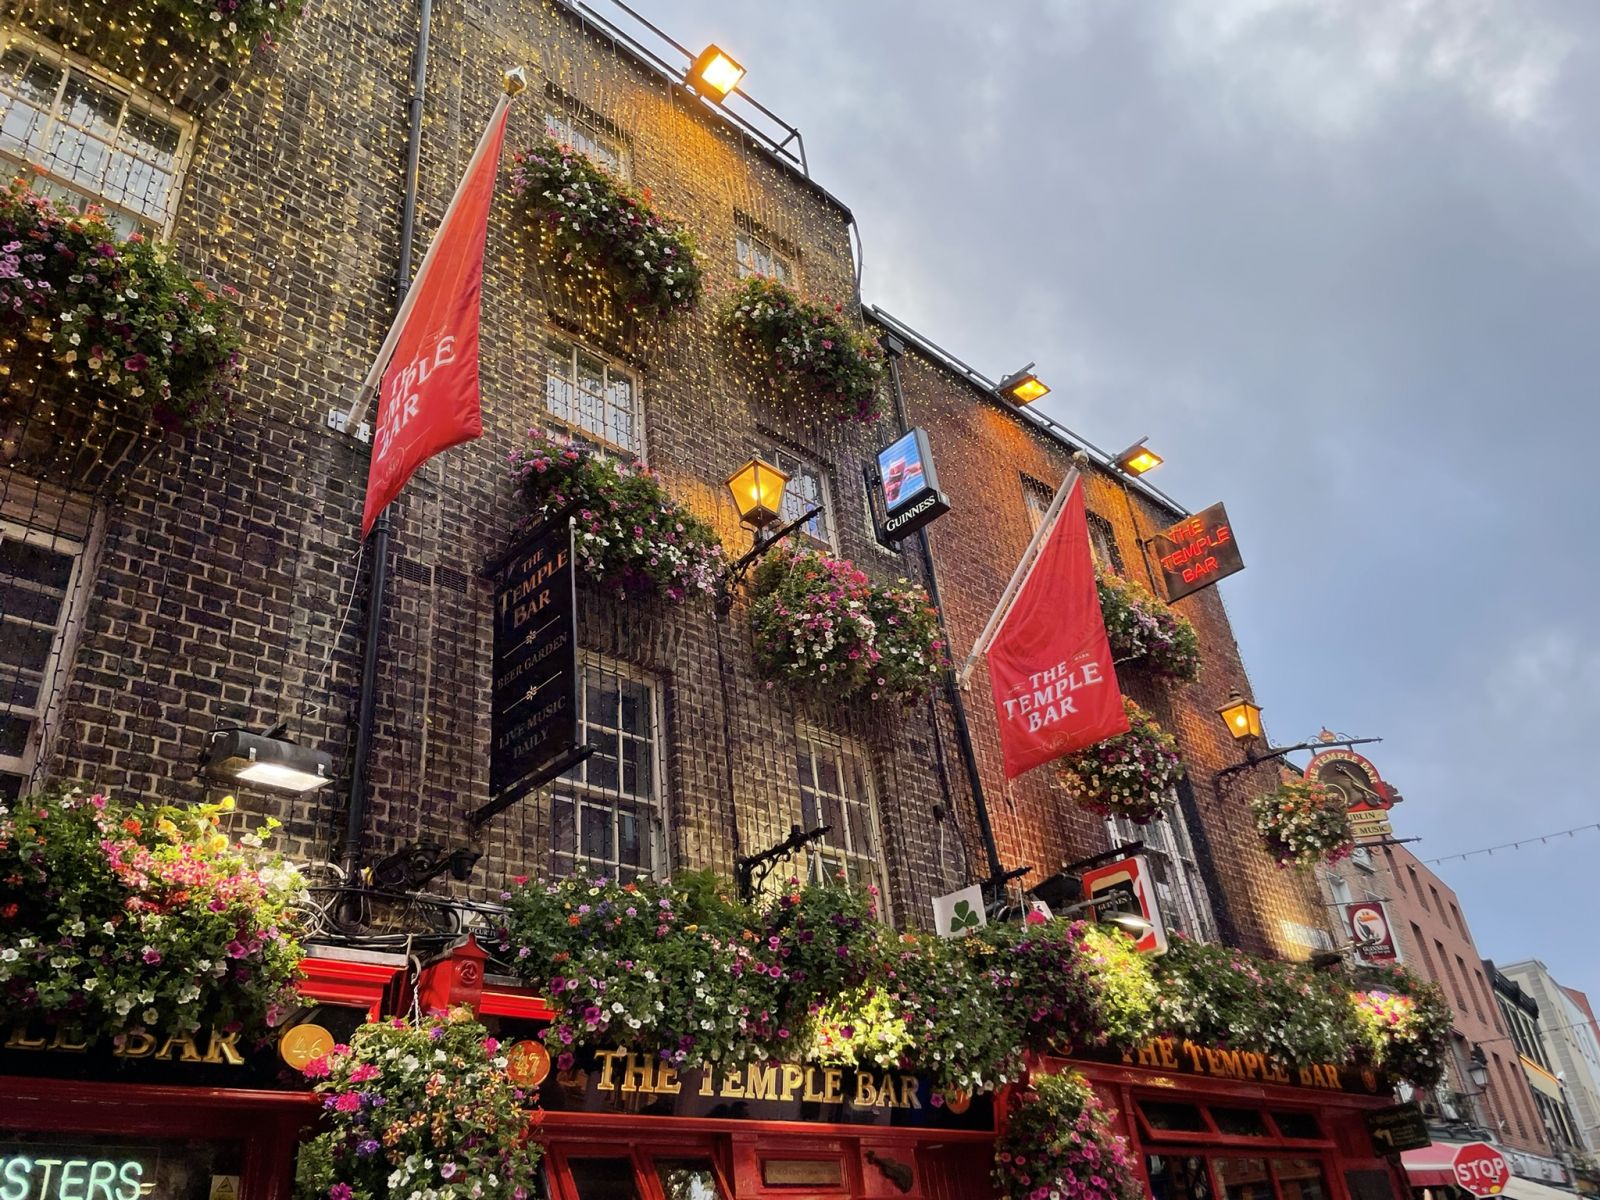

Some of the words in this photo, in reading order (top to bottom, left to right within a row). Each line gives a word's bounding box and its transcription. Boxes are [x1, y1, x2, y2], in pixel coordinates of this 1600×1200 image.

[886, 495, 936, 532] GUINNESS
[1168, 518, 1204, 545] THE
[521, 548, 545, 573] THE
[1161, 526, 1230, 569] TEMPLE
[499, 548, 568, 614] TEMPLE
[1182, 556, 1218, 583] BAR
[514, 589, 551, 628] BAR
[497, 664, 523, 690] BEER
[524, 632, 567, 670] GARDEN
[1028, 661, 1068, 689] THE
[1003, 661, 1103, 720] TEMPLE
[499, 722, 525, 750] LIVE
[527, 695, 566, 729] MUSIC
[1028, 696, 1079, 733] BAR
[513, 725, 549, 759] DAILY
[1314, 752, 1359, 767] TEMPLE
[1349, 811, 1376, 821] UBLIN
[1359, 825, 1387, 835] MUSIC
[112, 1024, 245, 1065] BAR
[292, 1036, 323, 1059] 46
[514, 1052, 540, 1077] 47
[595, 1050, 681, 1095] THE
[698, 1060, 844, 1105] TEMPLE
[854, 1071, 922, 1110] BAR
[1183, 1039, 1290, 1083] TEMPLE
[1299, 1063, 1342, 1089] BAR
[0, 1158, 143, 1200] STERS
[1457, 1157, 1504, 1181] STOP
